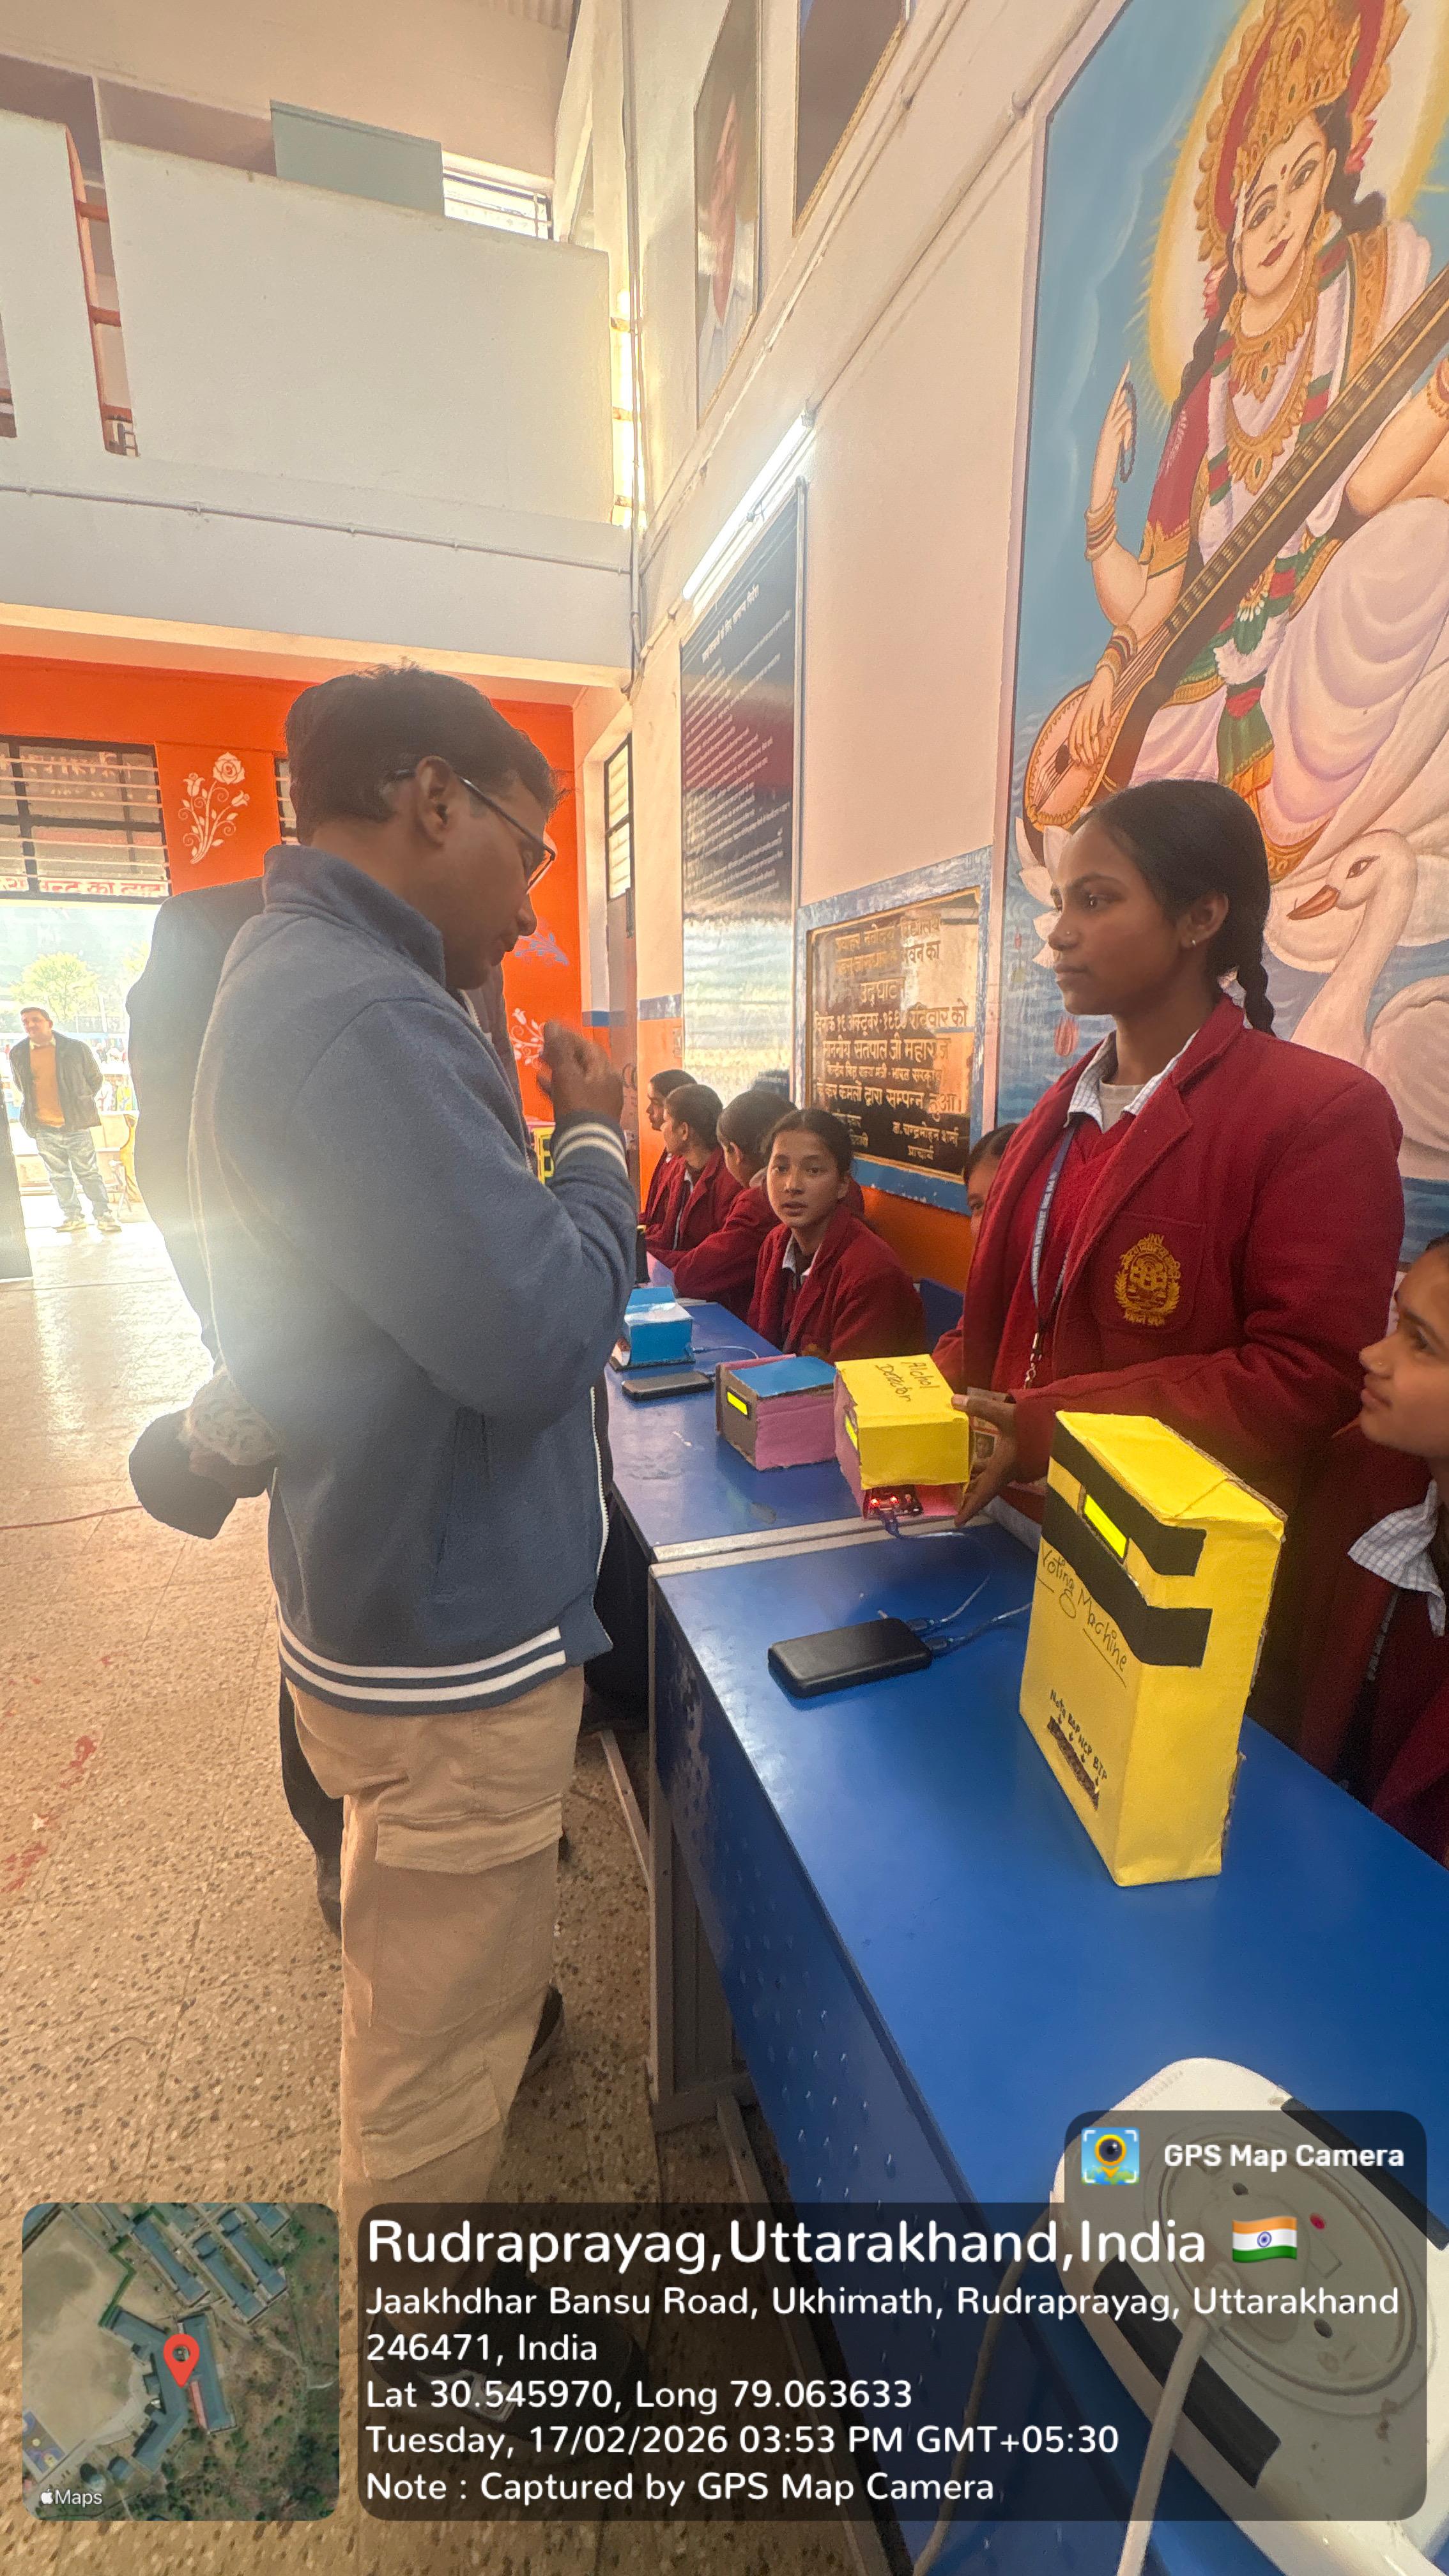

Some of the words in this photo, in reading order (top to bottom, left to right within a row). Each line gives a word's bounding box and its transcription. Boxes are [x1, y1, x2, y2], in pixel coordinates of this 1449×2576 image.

[926, 940, 941, 961] का
[952, 999, 968, 1027] को
[823, 1034, 851, 1059] माननीय
[854, 1039, 887, 1060] सतपाल
[890, 1032, 902, 1061] जी
[864, 1086, 883, 1107] द्वारा
[1144, 1232, 1165, 1245] JNV
[1041, 1544, 1077, 1619] Voting
[1077, 1588, 1128, 1673] Machine
